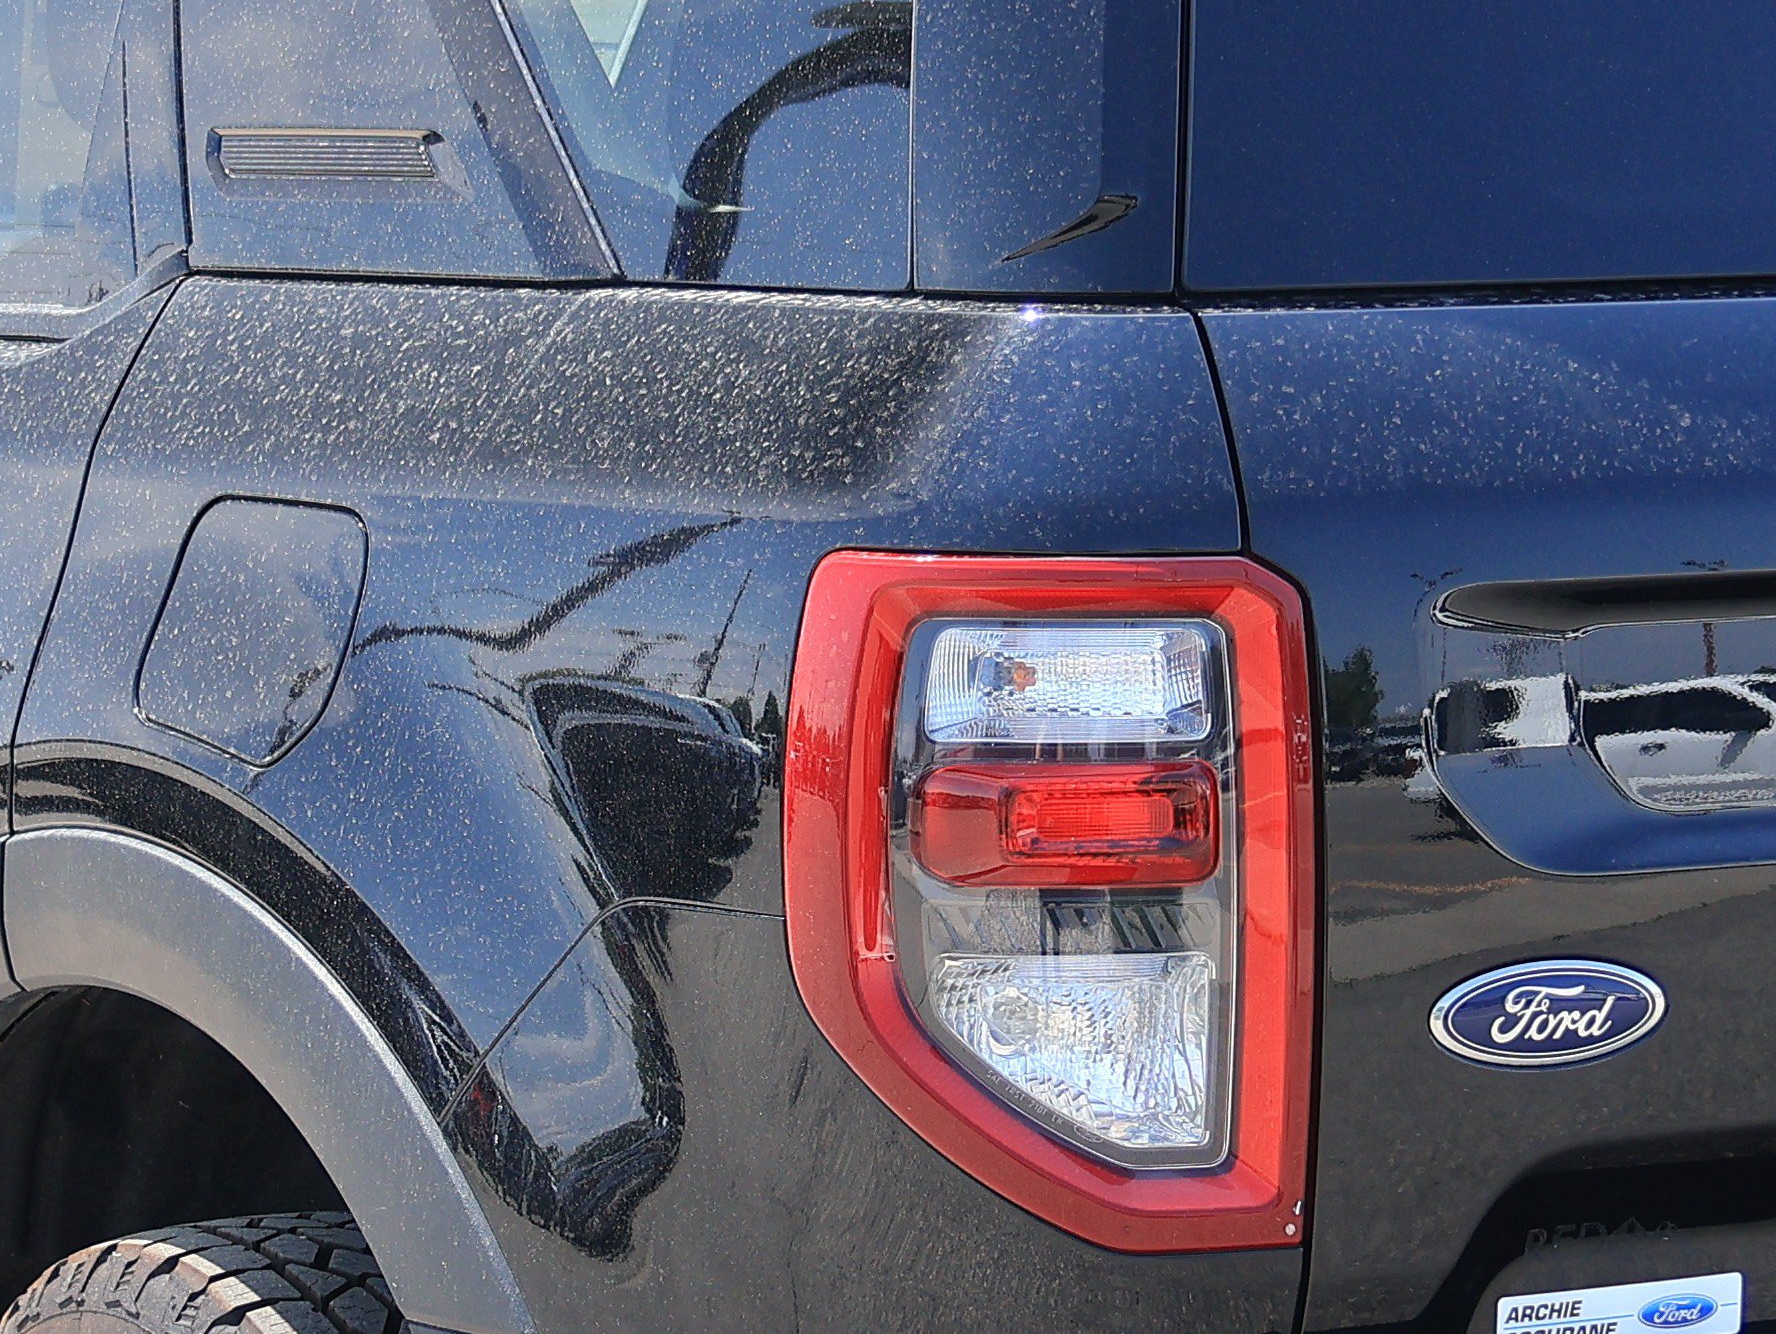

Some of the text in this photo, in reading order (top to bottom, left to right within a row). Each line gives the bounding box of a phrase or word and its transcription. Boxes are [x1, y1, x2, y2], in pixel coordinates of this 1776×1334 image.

[1490, 984, 1615, 1044] Ford
[1504, 1300, 1583, 1324] ARCHIE
[1653, 1300, 1701, 1324] Ford
